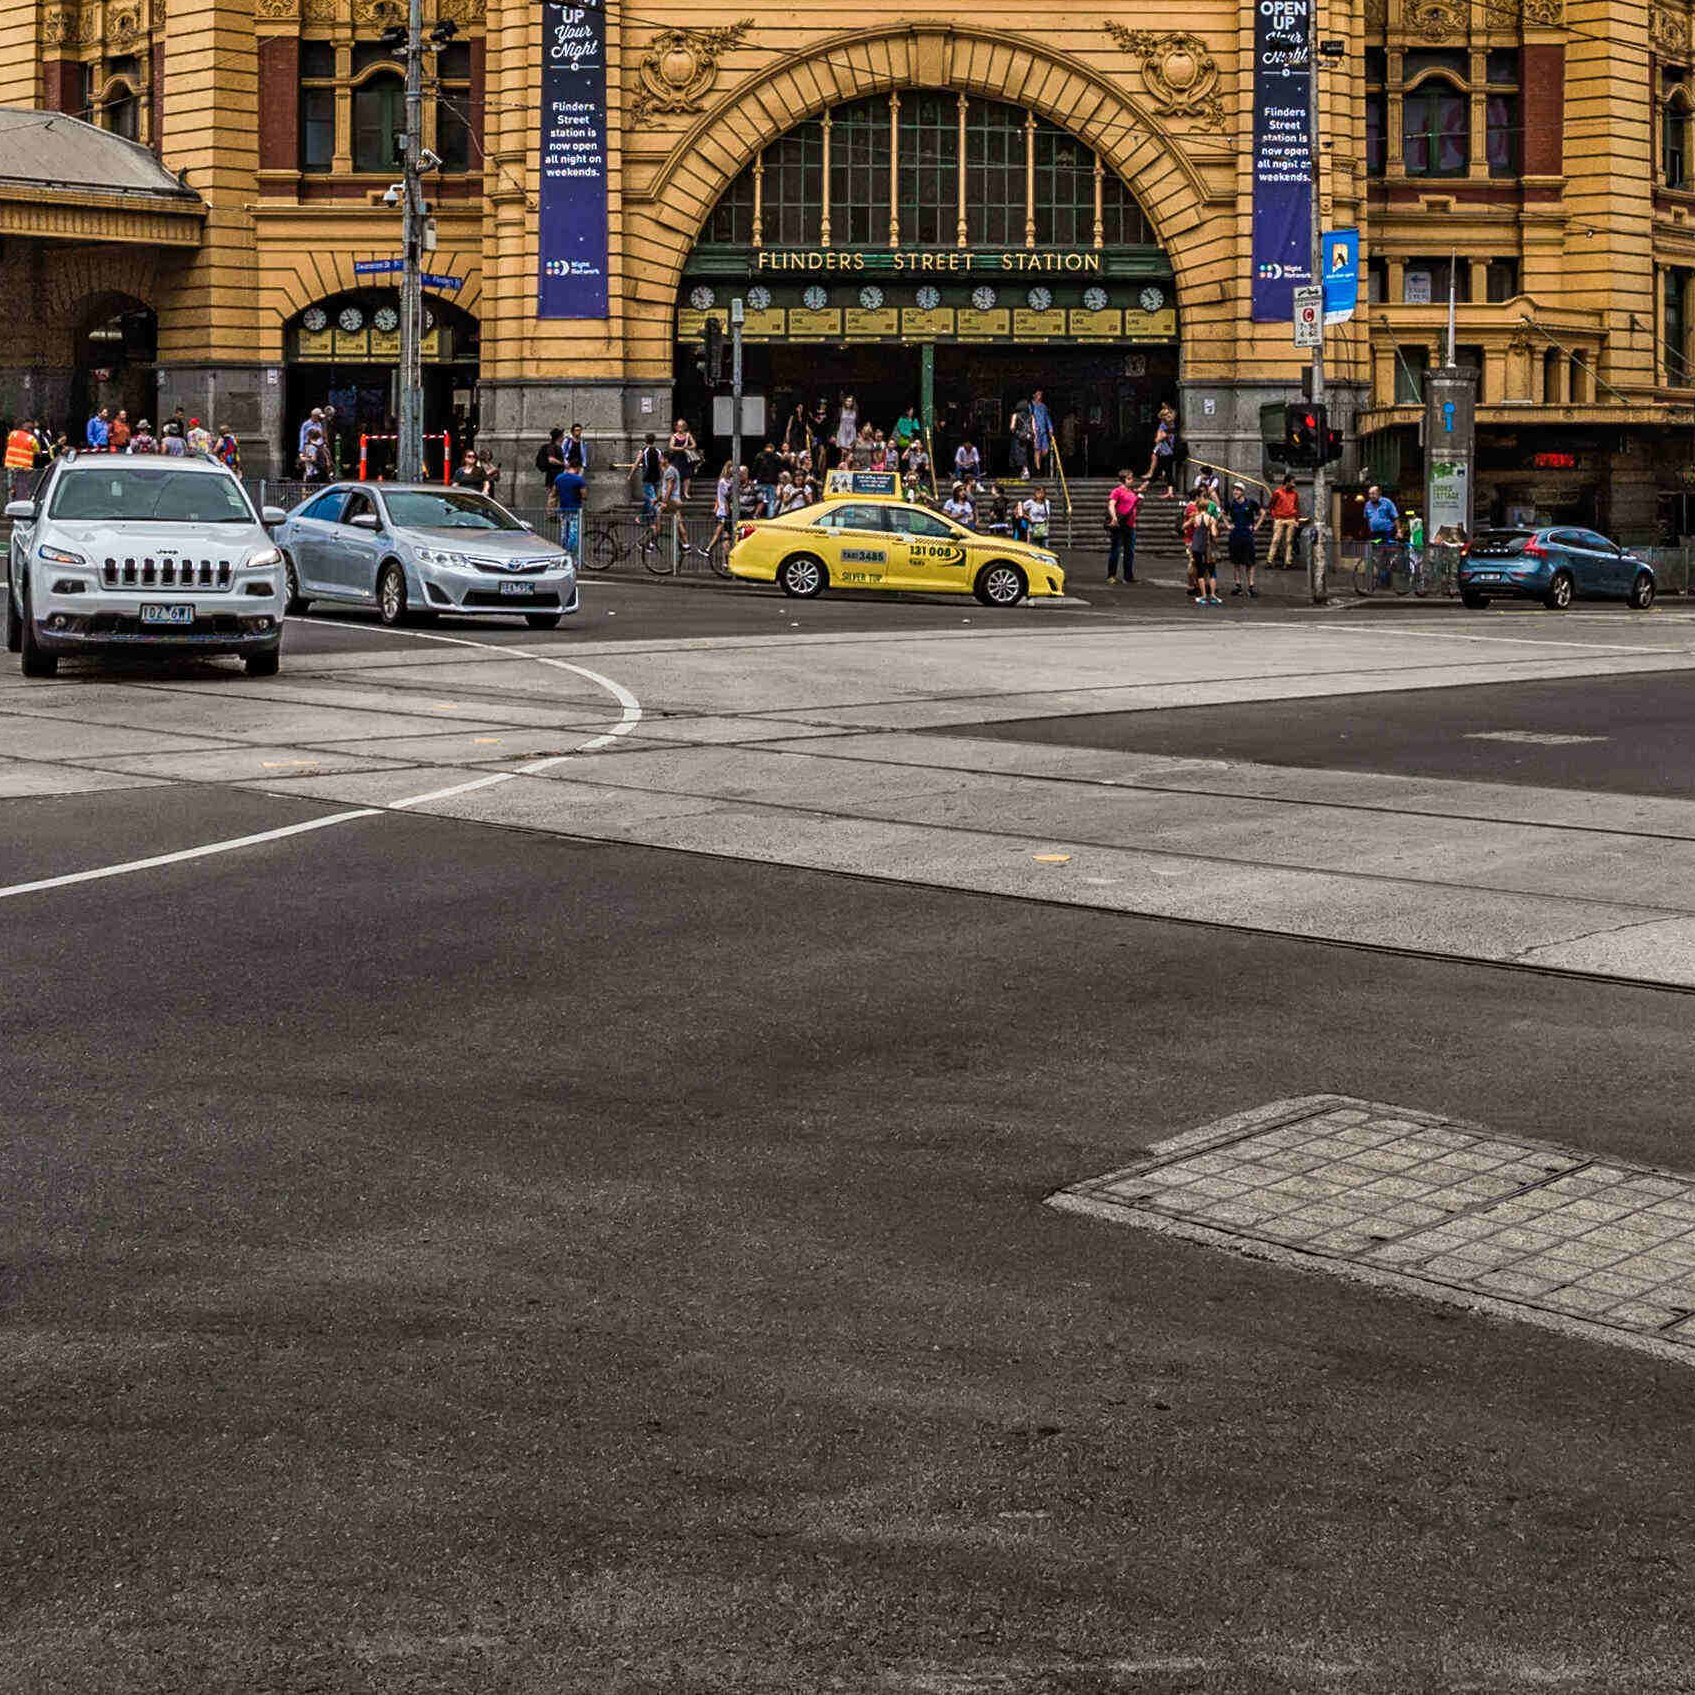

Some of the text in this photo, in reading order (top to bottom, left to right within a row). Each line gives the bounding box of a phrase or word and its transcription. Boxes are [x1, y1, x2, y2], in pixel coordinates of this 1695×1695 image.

[1260, 0, 1307, 16] OPEN
[562, 9, 585, 23] UP
[1273, 16, 1295, 30] UP
[554, 24, 593, 44] Your
[551, 39, 598, 61] Night
[552, 101, 595, 111] Flinders
[1264, 106, 1306, 116] Flinders
[557, 115, 590, 125] Street
[1269, 120, 1300, 130] Street
[550, 127, 597, 137] station is
[1262, 132, 1308, 143] station is
[572, 143, 598, 152] open
[1284, 148, 1309, 157] open
[545, 154, 602, 165] all night on
[1257, 159, 1271, 169] all
[1272, 159, 1298, 171] night
[546, 167, 600, 177] weekends.
[1259, 172, 1312, 182] weekends.
[758, 252, 1100, 272] FLINDERS STREET STATION
[909, 545, 926, 555] 131
